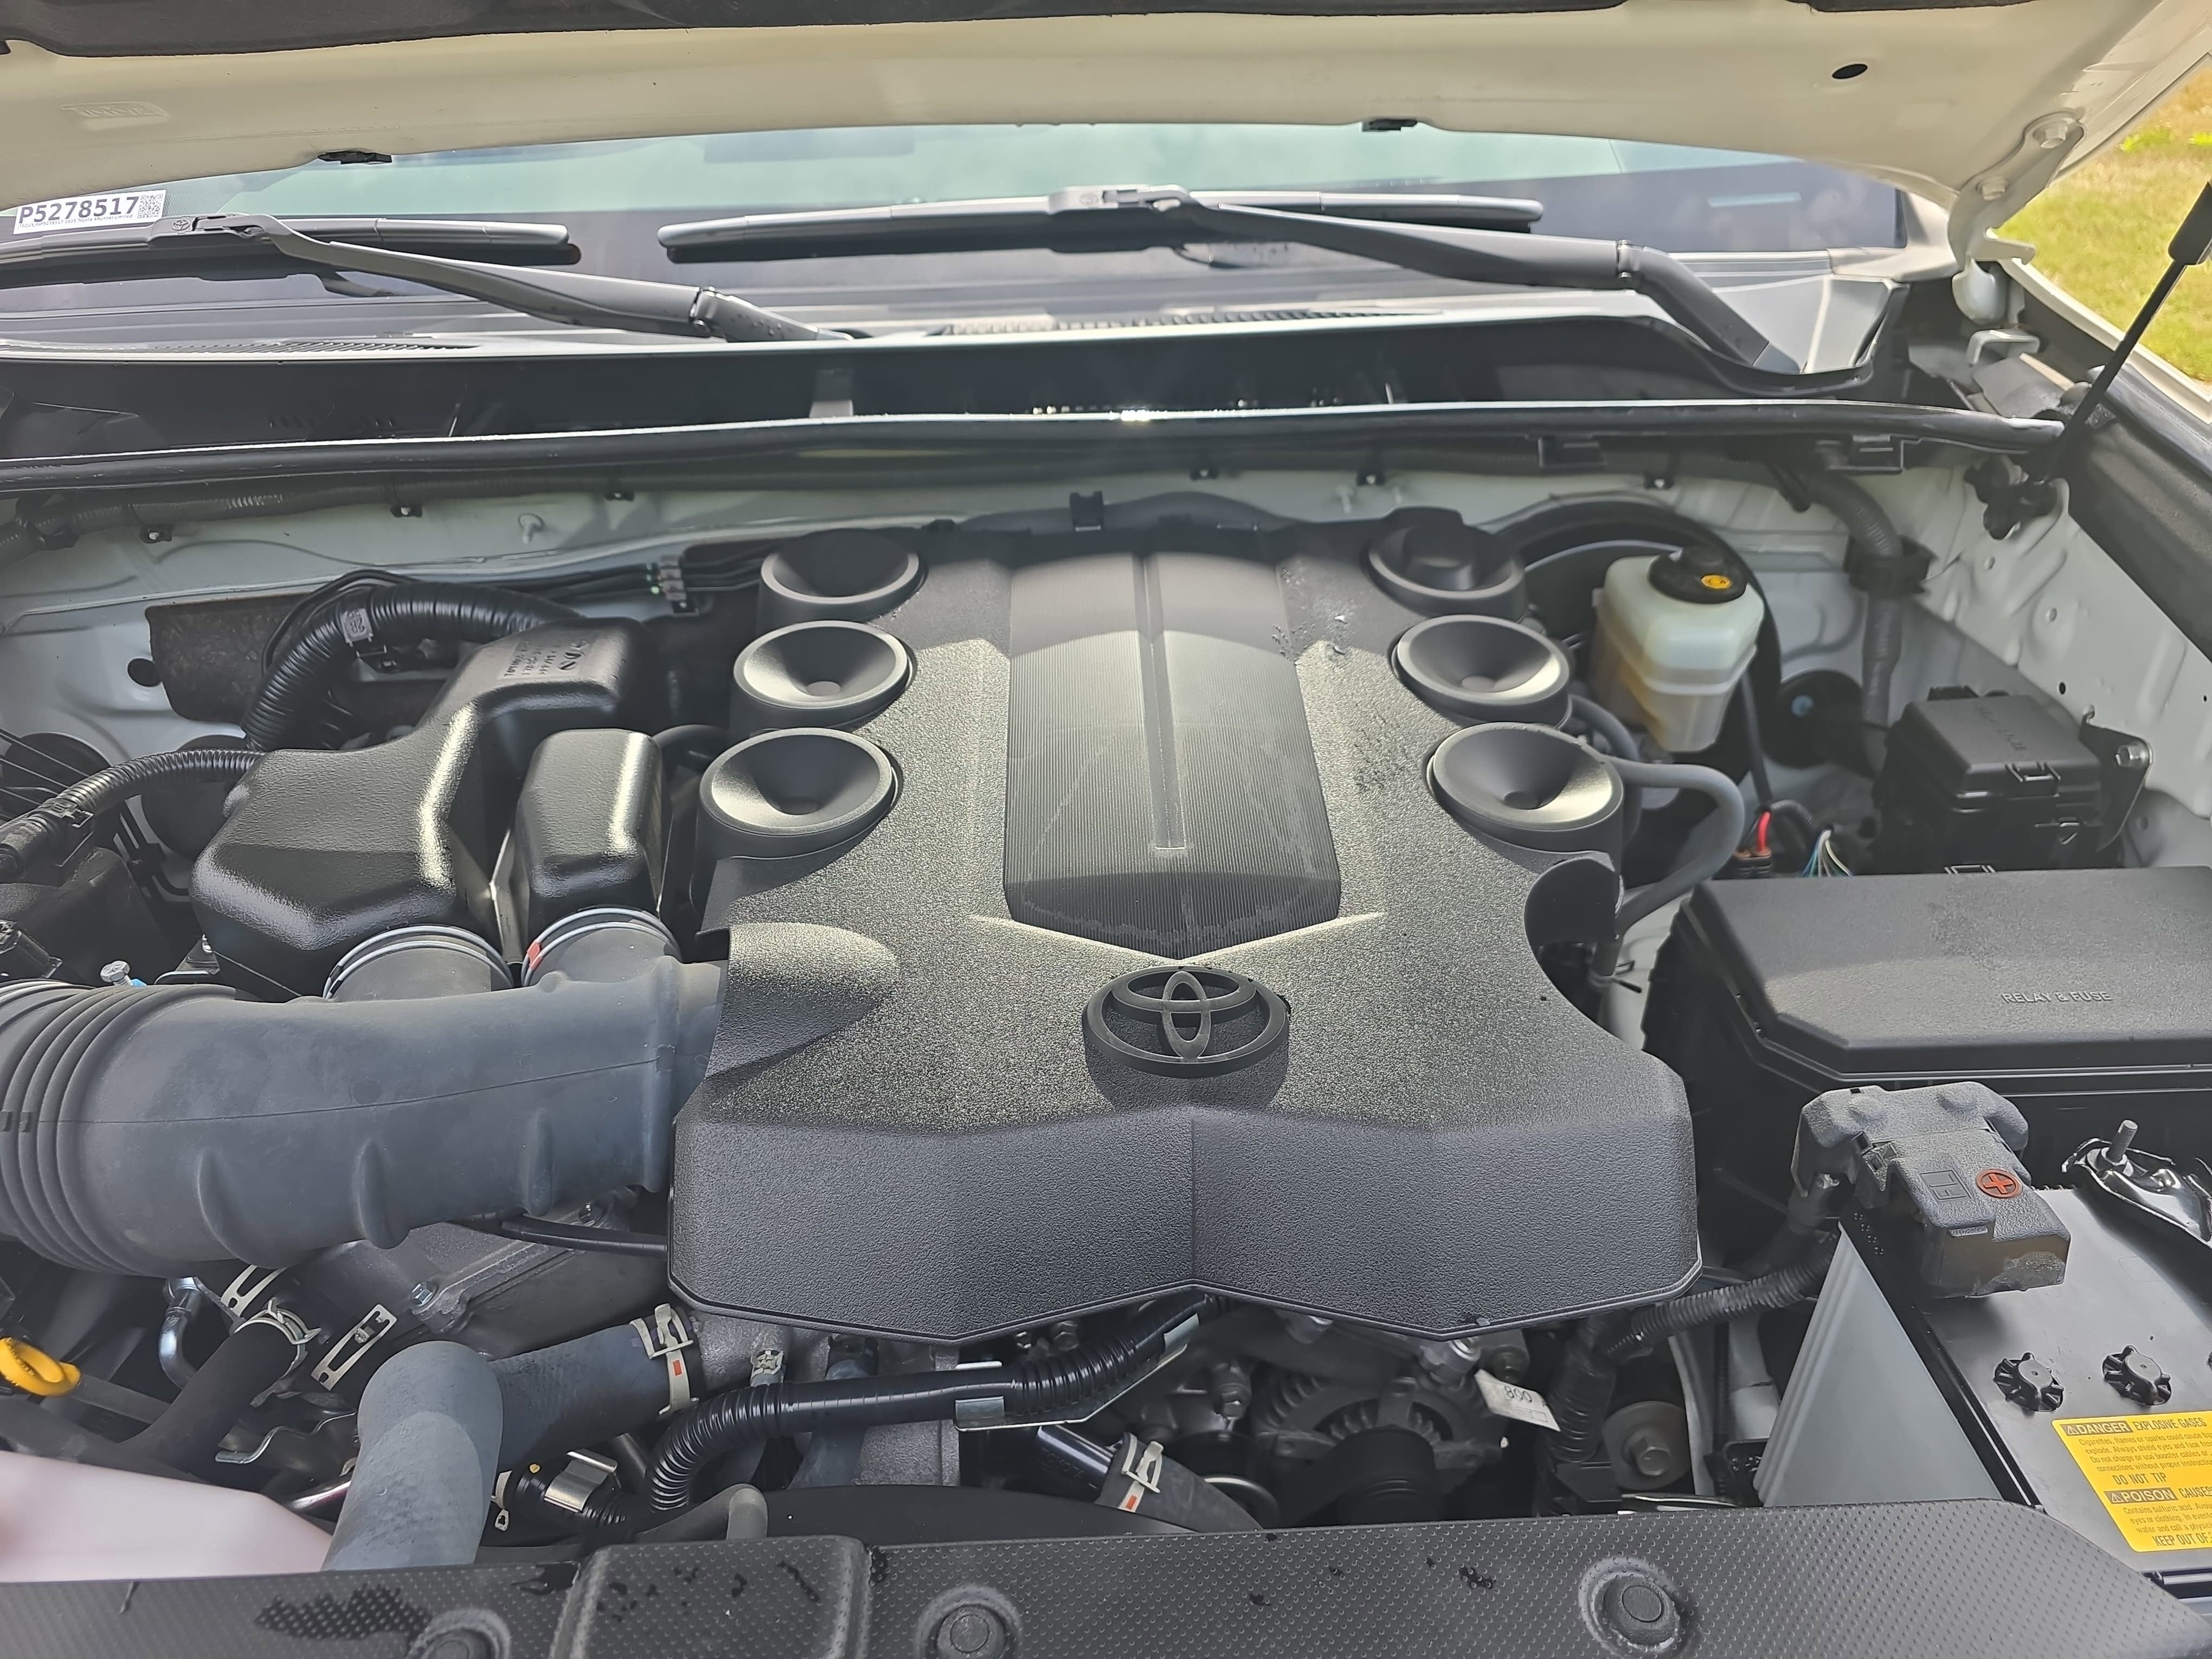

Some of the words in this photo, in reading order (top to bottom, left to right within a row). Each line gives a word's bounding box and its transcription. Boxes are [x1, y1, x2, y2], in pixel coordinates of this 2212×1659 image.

[19, 196, 139, 224] P5278517
[2001, 992, 2052, 1004] RELAY
[2055, 991, 2069, 1002] &
[2069, 991, 2113, 1001] FUSE
[2075, 1422, 2130, 1434] DANGER
[2132, 1419, 2178, 1431] EXPLOSIVE
[2177, 1417, 2207, 1428] GASES
[2079, 1438, 2114, 1446] Cigarettes,
[2145, 1435, 2166, 1443] sparks
[2085, 1446, 2113, 1455] explode.
[2113, 1445, 2138, 1454] Always
[2113, 1454, 2134, 1463] charge
[2097, 1464, 2134, 1472] connections
[2134, 1462, 2160, 1470] without
[2159, 1461, 2181, 1470] proper
[2112, 1475, 2129, 1486] DO
[2129, 1473, 2150, 1484] NOT
[2150, 1472, 2167, 1483] TIP
[2120, 1489, 2175, 1502] POISON
[2123, 1506, 2153, 1514] Contains
[2152, 1504, 2178, 1513] sulfuric
[2178, 1503, 2196, 1512] acid.
[2155, 1515, 2184, 1523] clothing.
[2157, 1524, 2170, 1532] and
[2170, 1523, 2183, 1532] call
[2152, 1534, 2176, 1547] KEEP
[2176, 1533, 2196, 1545] OUT
[2195, 1532, 2209, 1544] OF
